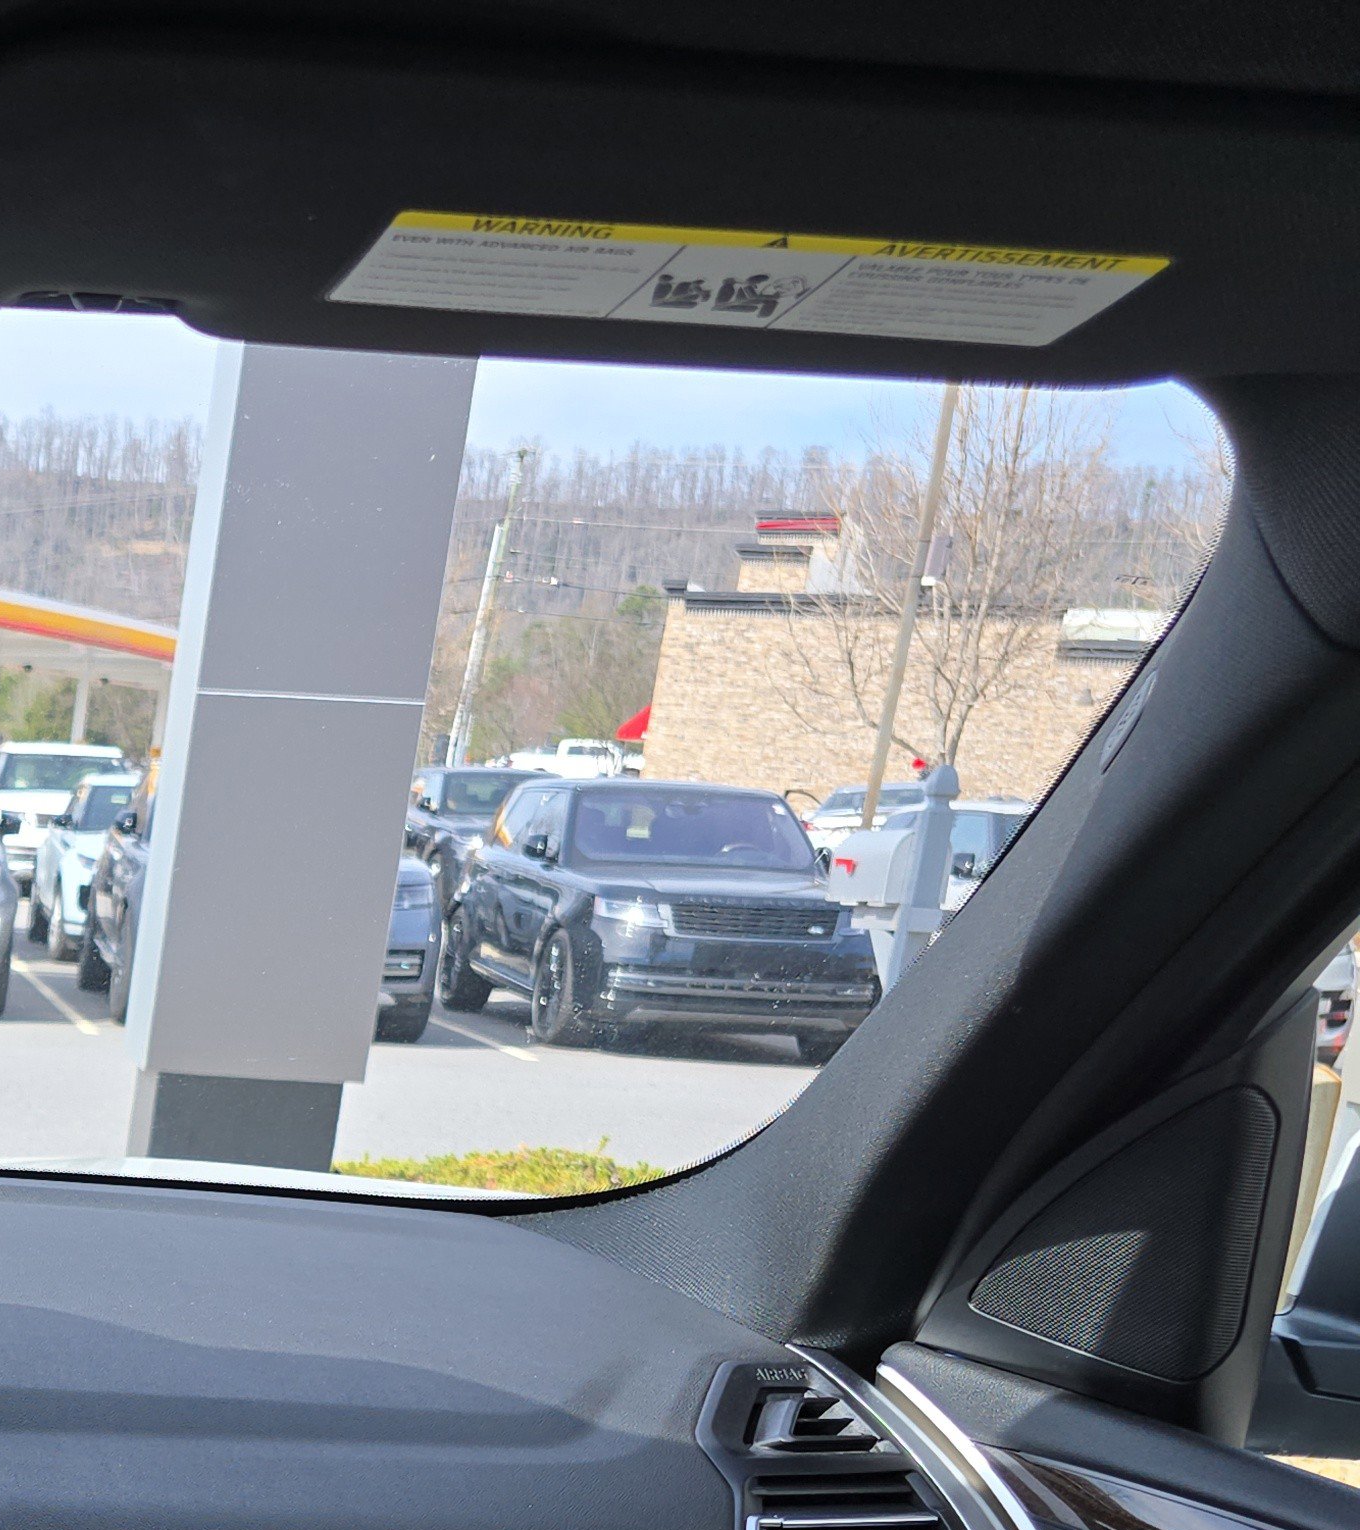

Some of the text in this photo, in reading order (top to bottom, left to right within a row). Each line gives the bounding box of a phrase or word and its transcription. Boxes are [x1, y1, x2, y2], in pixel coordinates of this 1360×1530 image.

[471, 218, 616, 240] WARNING
[871, 243, 1127, 271] AVERTISSEMENT
[755, 1367, 809, 1382] AIRBAG
